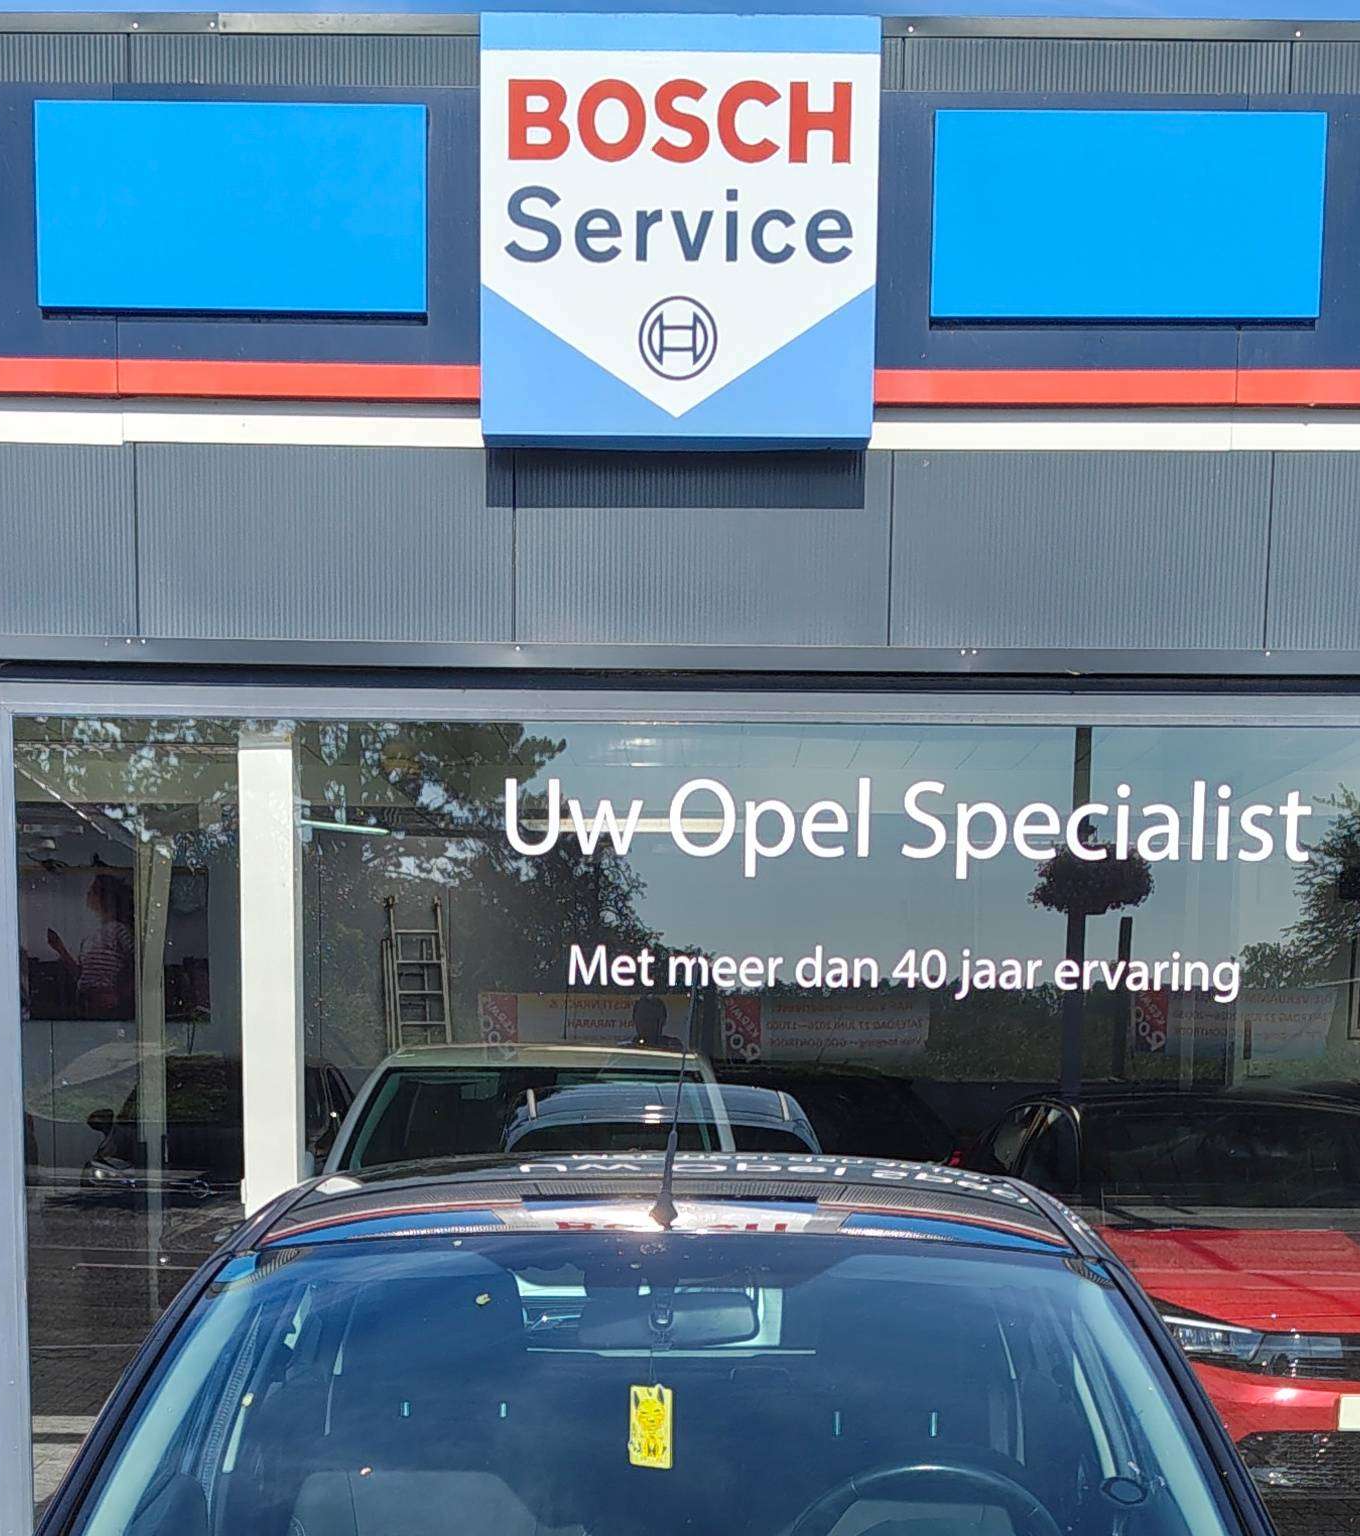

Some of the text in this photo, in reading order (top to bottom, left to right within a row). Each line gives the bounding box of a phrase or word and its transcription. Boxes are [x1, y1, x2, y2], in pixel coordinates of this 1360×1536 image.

[508, 79, 852, 163] BOSCH
[505, 185, 853, 264] Service
[506, 776, 1312, 880] Uw Opel Specialist
[568, 944, 1240, 1003] Met meer dan 40 jaar ervaring
